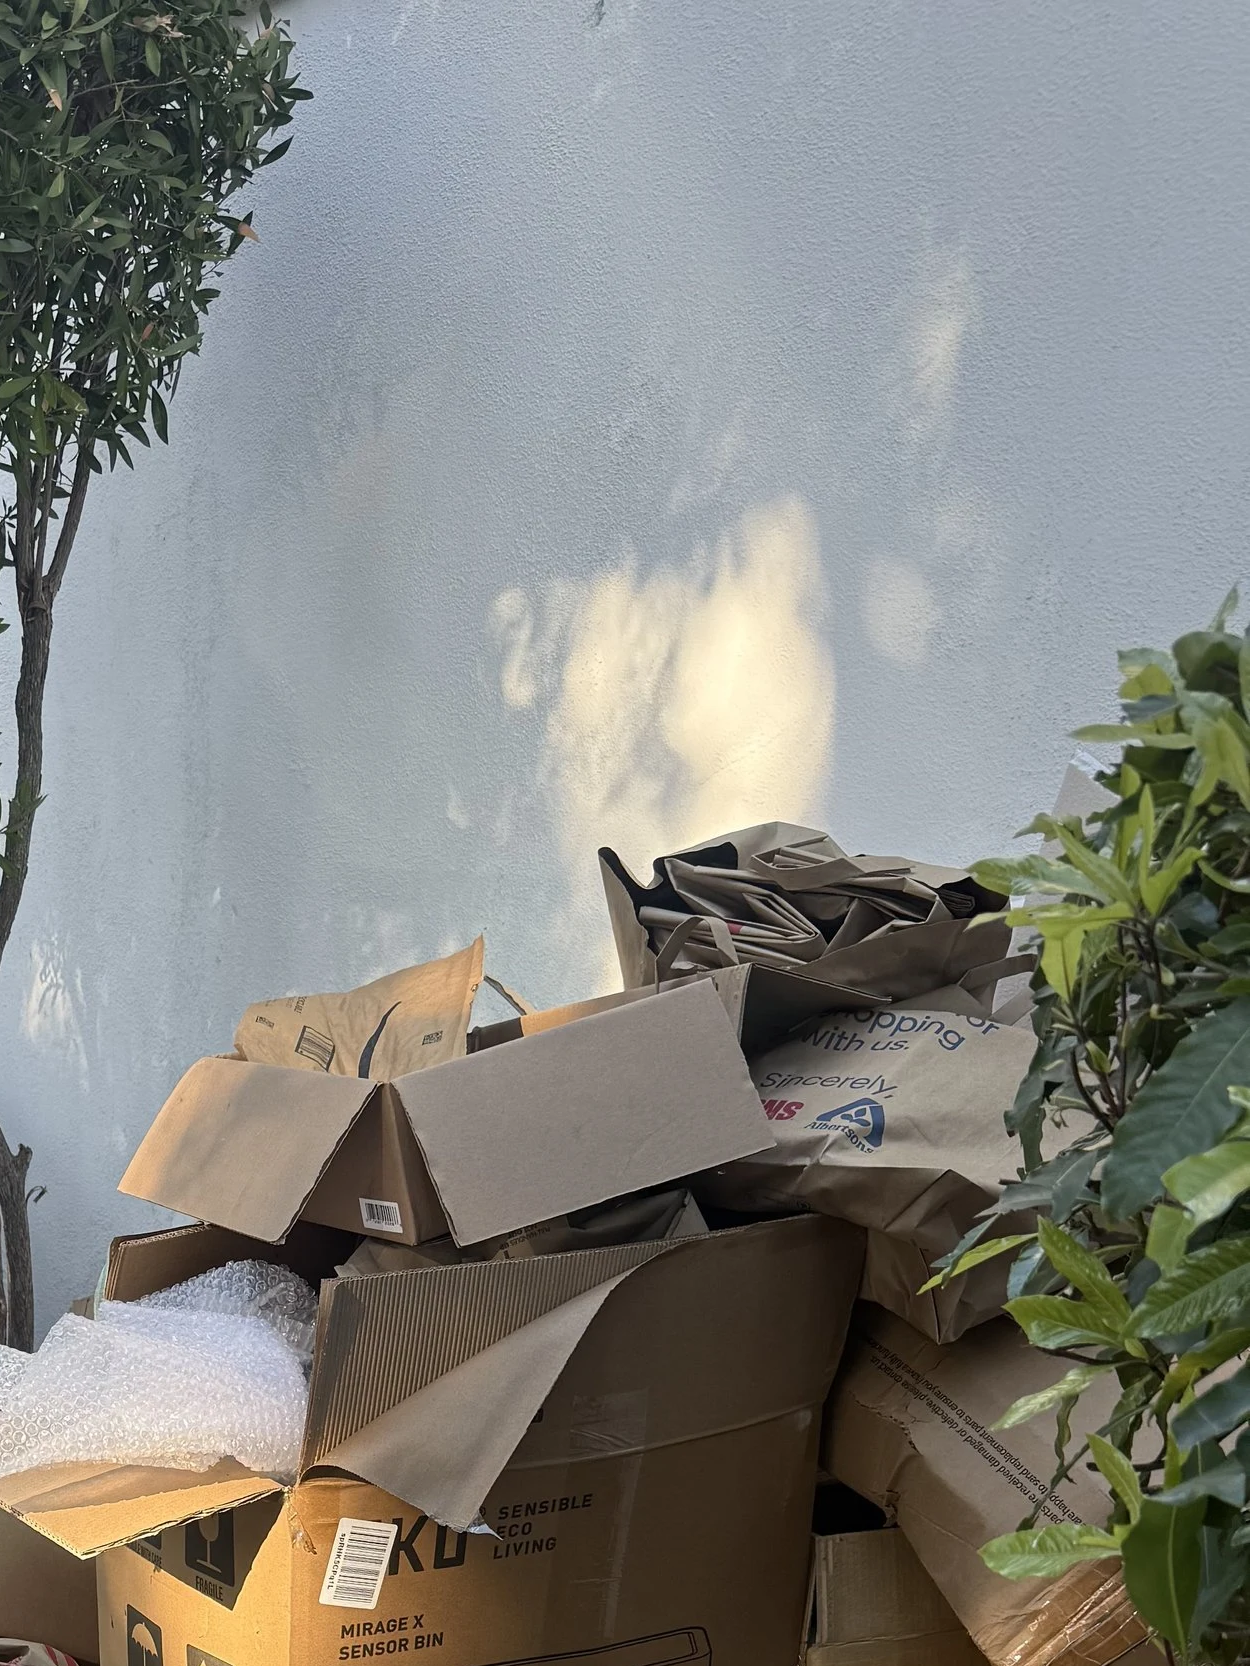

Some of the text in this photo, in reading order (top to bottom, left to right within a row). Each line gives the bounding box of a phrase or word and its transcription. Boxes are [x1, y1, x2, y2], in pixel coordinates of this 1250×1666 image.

[955, 1012, 1000, 1035] or
[871, 1039, 909, 1051] us.
[759, 1072, 897, 1099] Sincerely,
[760, 1099, 805, 1121] NS
[804, 1121, 874, 1155] Albertsons
[877, 1361, 902, 1382] contact
[900, 1379, 927, 1400] please
[933, 1389, 957, 1410] ensure
[925, 1397, 958, 1428] defective,
[955, 1408, 965, 1418] to
[962, 1415, 984, 1432] parts
[955, 1428, 967, 1437] or
[962, 1435, 999, 1467] damaged
[979, 1430, 1023, 1470] replacement
[995, 1465, 1030, 1495] received
[1018, 1468, 1040, 1485] send
[1037, 1484, 1048, 1494] to
[498, 1494, 594, 1520] SENSIBLE
[1040, 1505, 1064, 1524] parts
[1067, 1511, 1082, 1524] are
[497, 1522, 532, 1540] ECO
[382, 1514, 468, 1577] KO
[493, 1538, 557, 1560] LIVING
[195, 1575, 224, 1601] FRAGILE
[341, 1614, 425, 1639] MIRAGE X
[339, 1632, 444, 1661] SENSOR BIN
